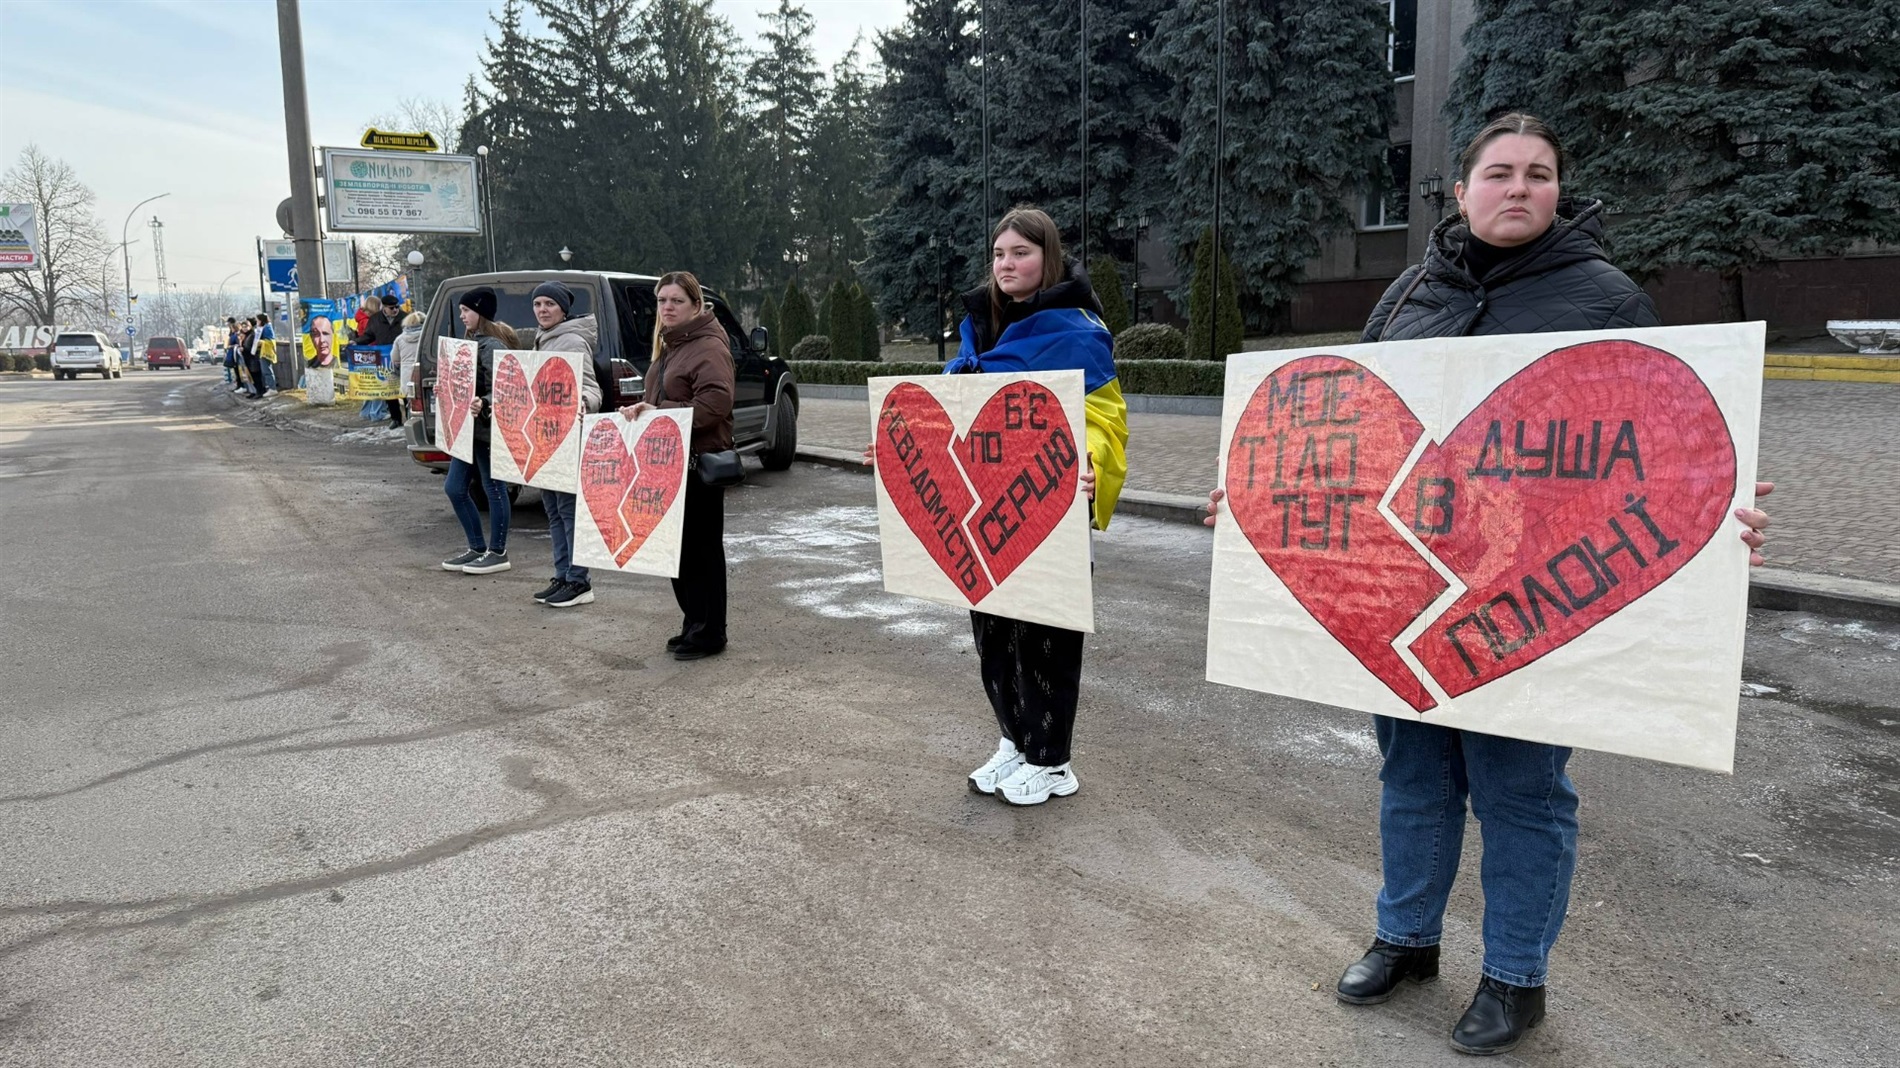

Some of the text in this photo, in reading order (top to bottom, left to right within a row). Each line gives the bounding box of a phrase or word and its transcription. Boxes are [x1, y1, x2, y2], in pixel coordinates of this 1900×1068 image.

[357, 207, 375, 215] 096
[378, 208, 389, 216] 55
[405, 209, 422, 217] 967
[534, 416, 559, 441] ТАМ
[1267, 369, 1365, 429] МОЄ
[970, 431, 1003, 464] ПО
[1239, 429, 1359, 489] ТІЛО
[1467, 419, 1645, 482] ДУША
[978, 427, 1077, 555] СЕРЦЮ
[1414, 477, 1453, 535] В
[1272, 493, 1366, 551] ТУТ
[1445, 492, 1680, 678] ПОЛОНІ
